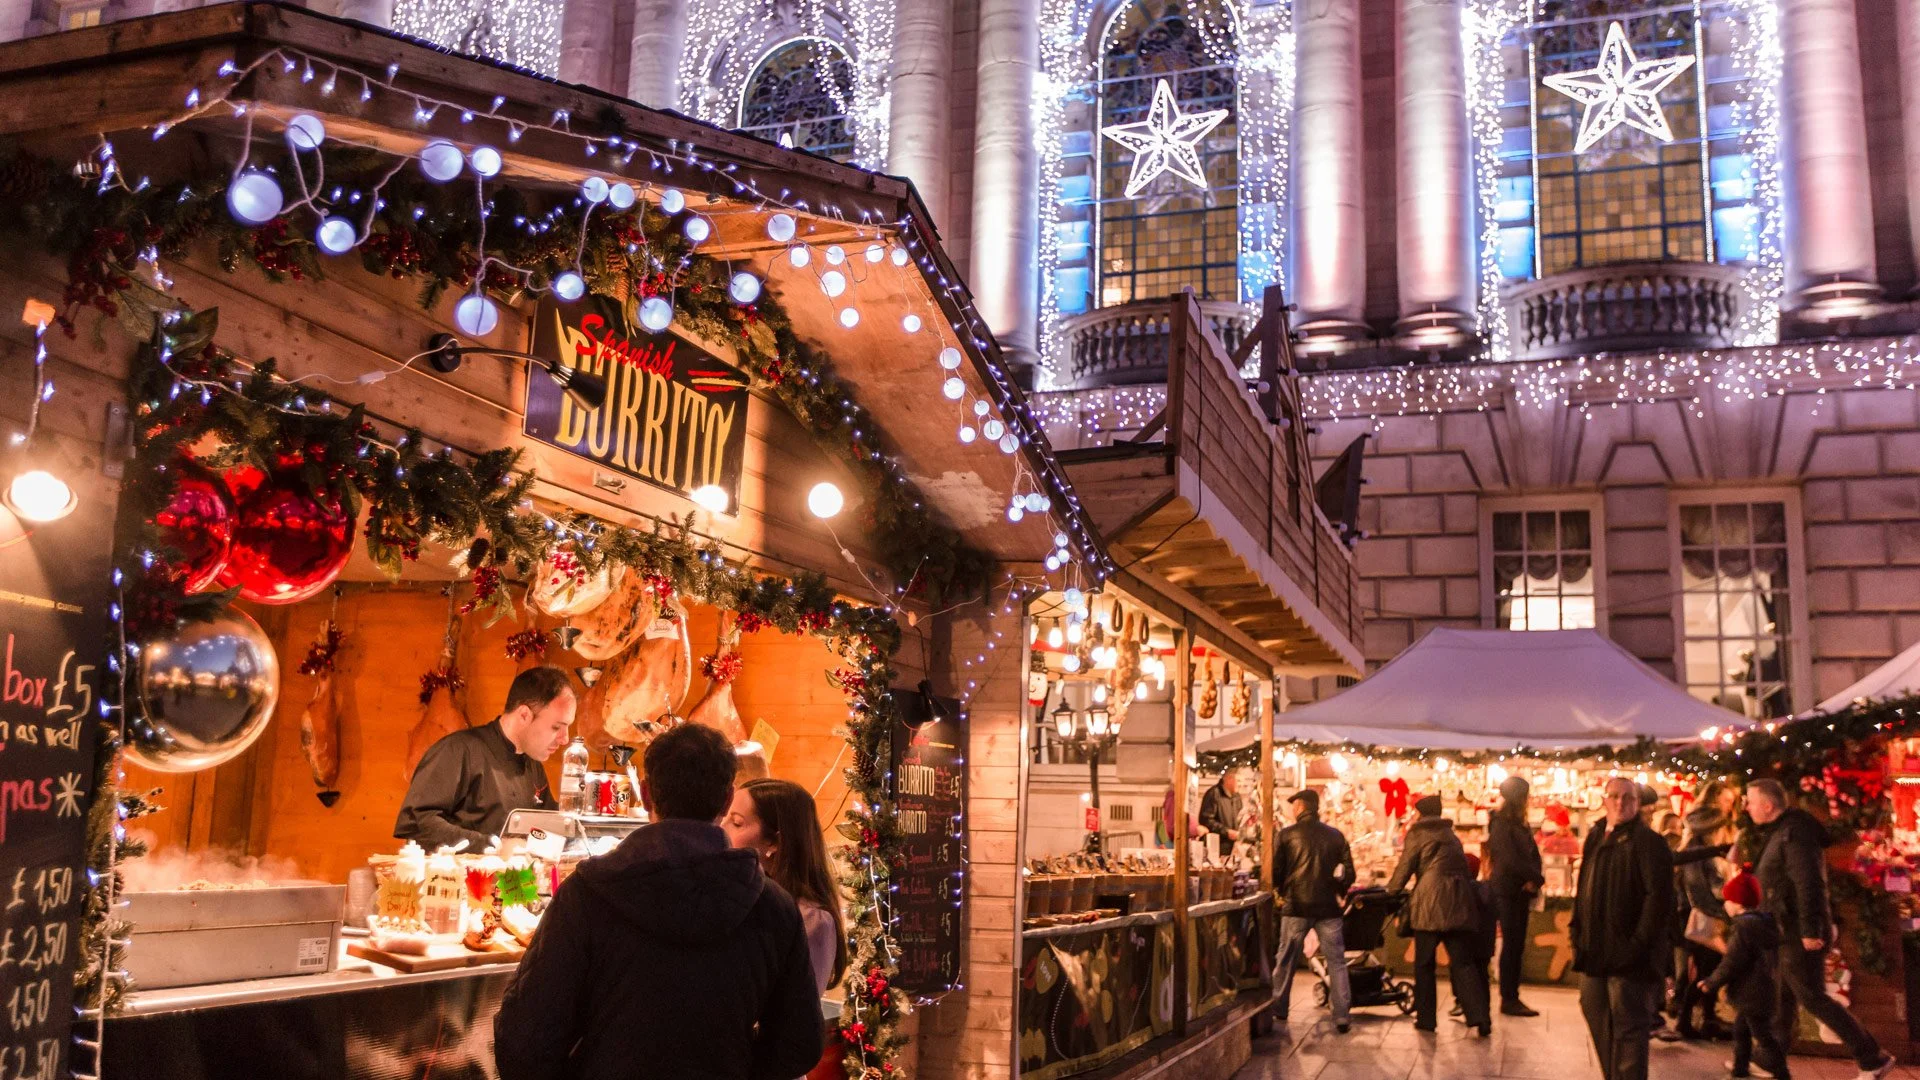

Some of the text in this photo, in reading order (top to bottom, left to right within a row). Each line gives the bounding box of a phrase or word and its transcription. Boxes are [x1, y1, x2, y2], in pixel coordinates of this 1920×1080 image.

[576, 313, 677, 380] Spanish
[555, 308, 736, 494] BURRITO
[4, 633, 96, 723] box £5
[15, 724, 38, 744] as
[898, 764, 935, 796] BURRITO
[898, 810, 927, 834] BURRITO
